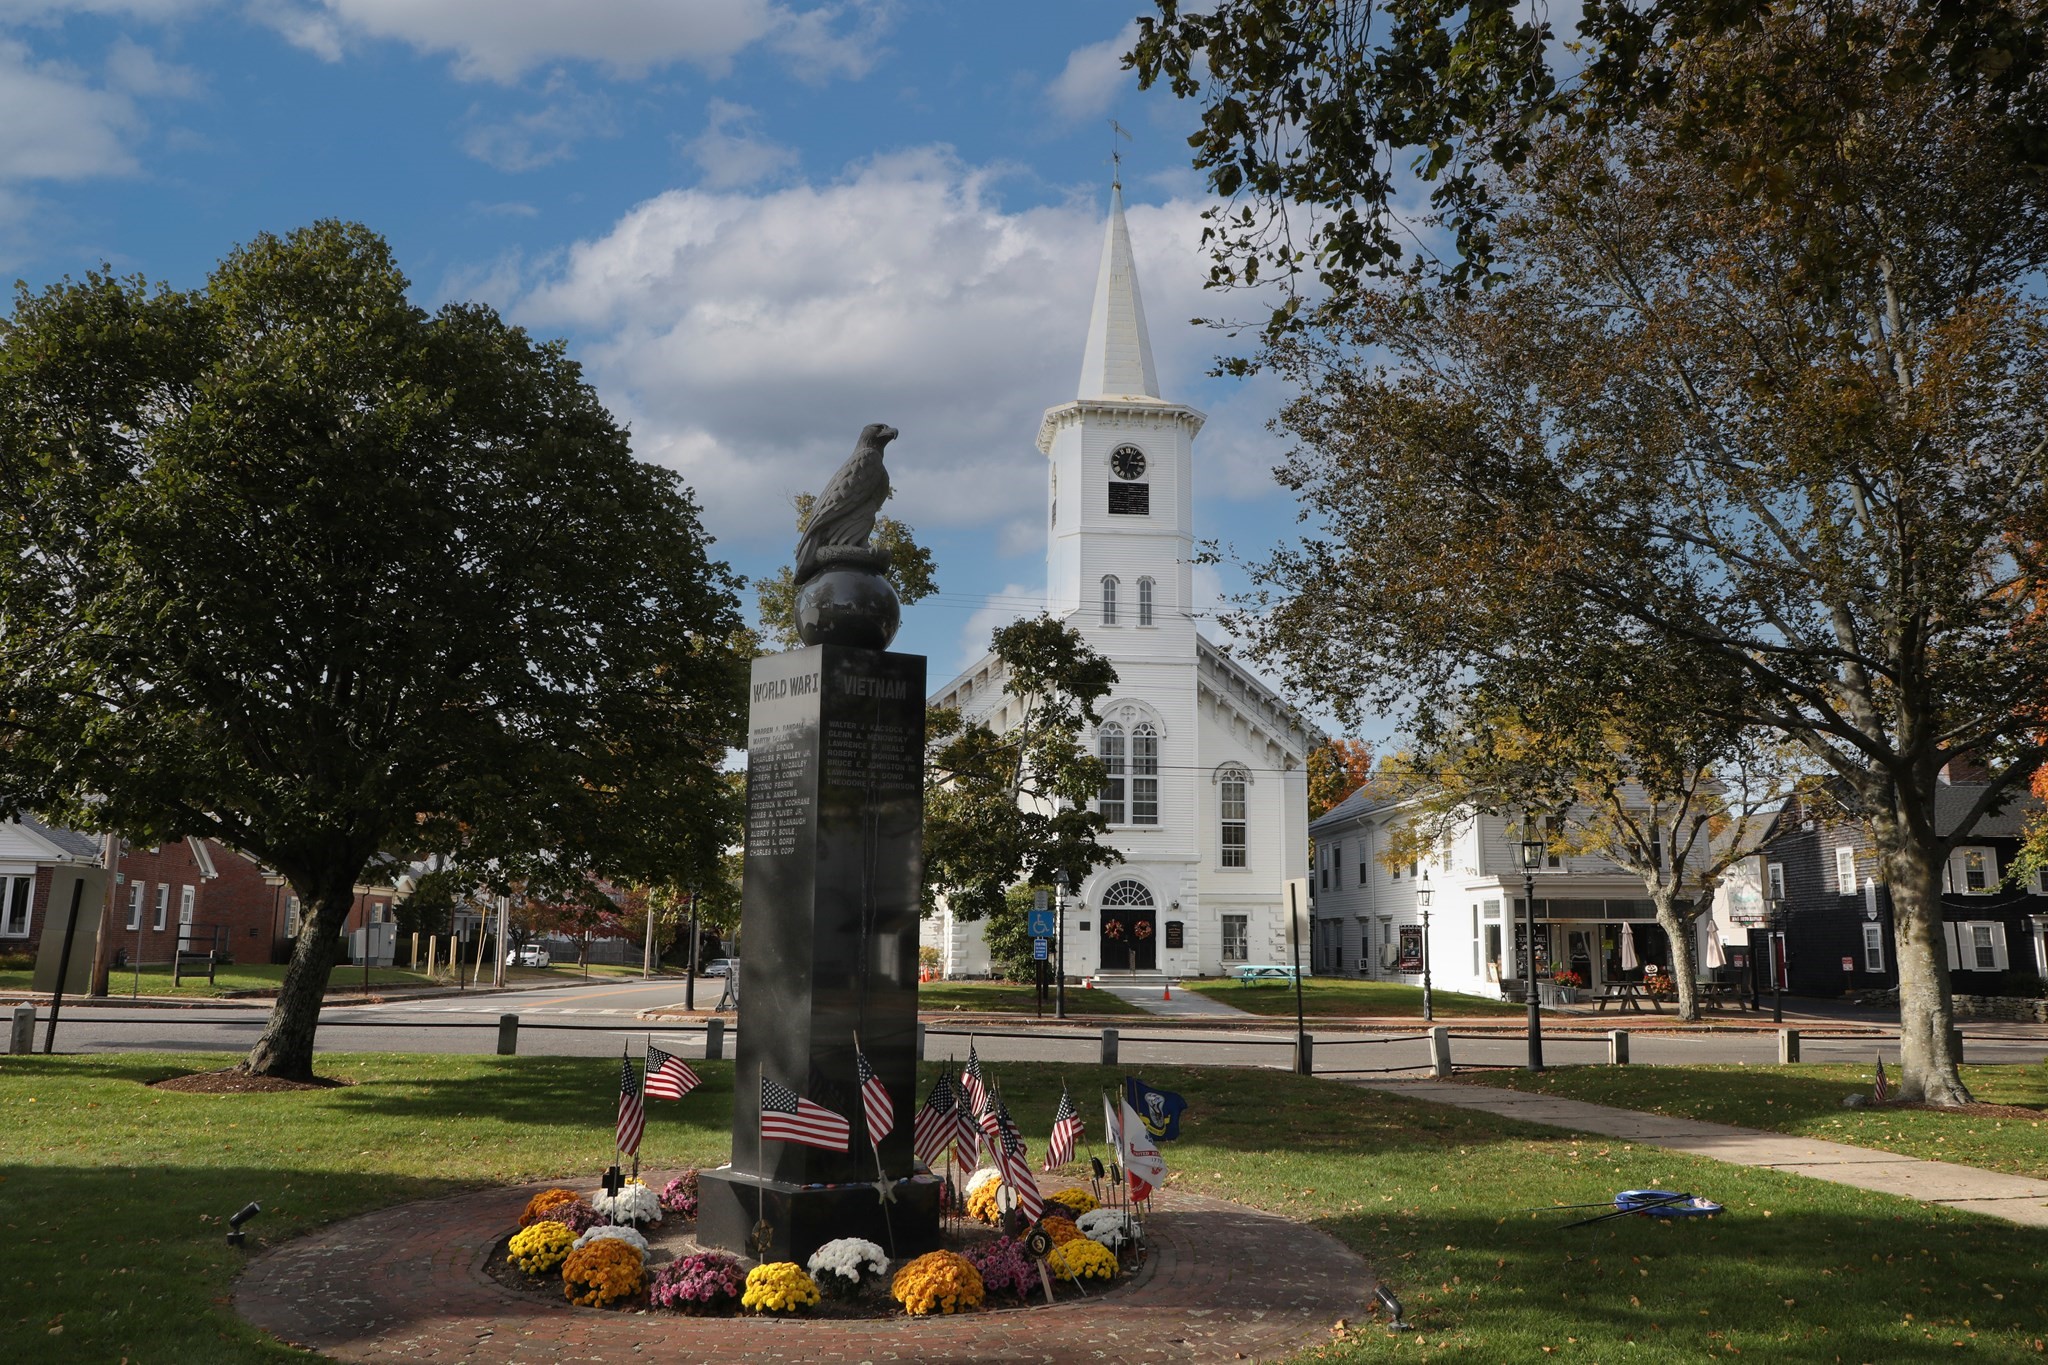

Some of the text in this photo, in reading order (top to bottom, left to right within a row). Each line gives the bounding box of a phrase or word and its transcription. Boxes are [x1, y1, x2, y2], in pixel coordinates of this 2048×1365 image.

[754, 673, 818, 703] WORLD WAR I
[844, 676, 906, 699] VIETNAM
[829, 721, 856, 729] WALTER
[828, 730, 852, 739] GLENN
[828, 740, 867, 749] LAWRENCE
[827, 750, 857, 758] ROBERT
[753, 755, 774, 763] CHARLES
[827, 759, 852, 767] BRUCE
[753, 764, 772, 772] THOMAS
[827, 769, 867, 777] LAWRENCE
[752, 774, 770, 782] JOSEPH
[827, 778, 867, 787] THEODORE
[752, 783, 772, 791] ANTONIO
[773, 790, 797, 798] ANDREWS
[751, 801, 775, 810] FREDERICK
[785, 798, 810, 806] COCHRANE
[751, 811, 766, 819] JAMES
